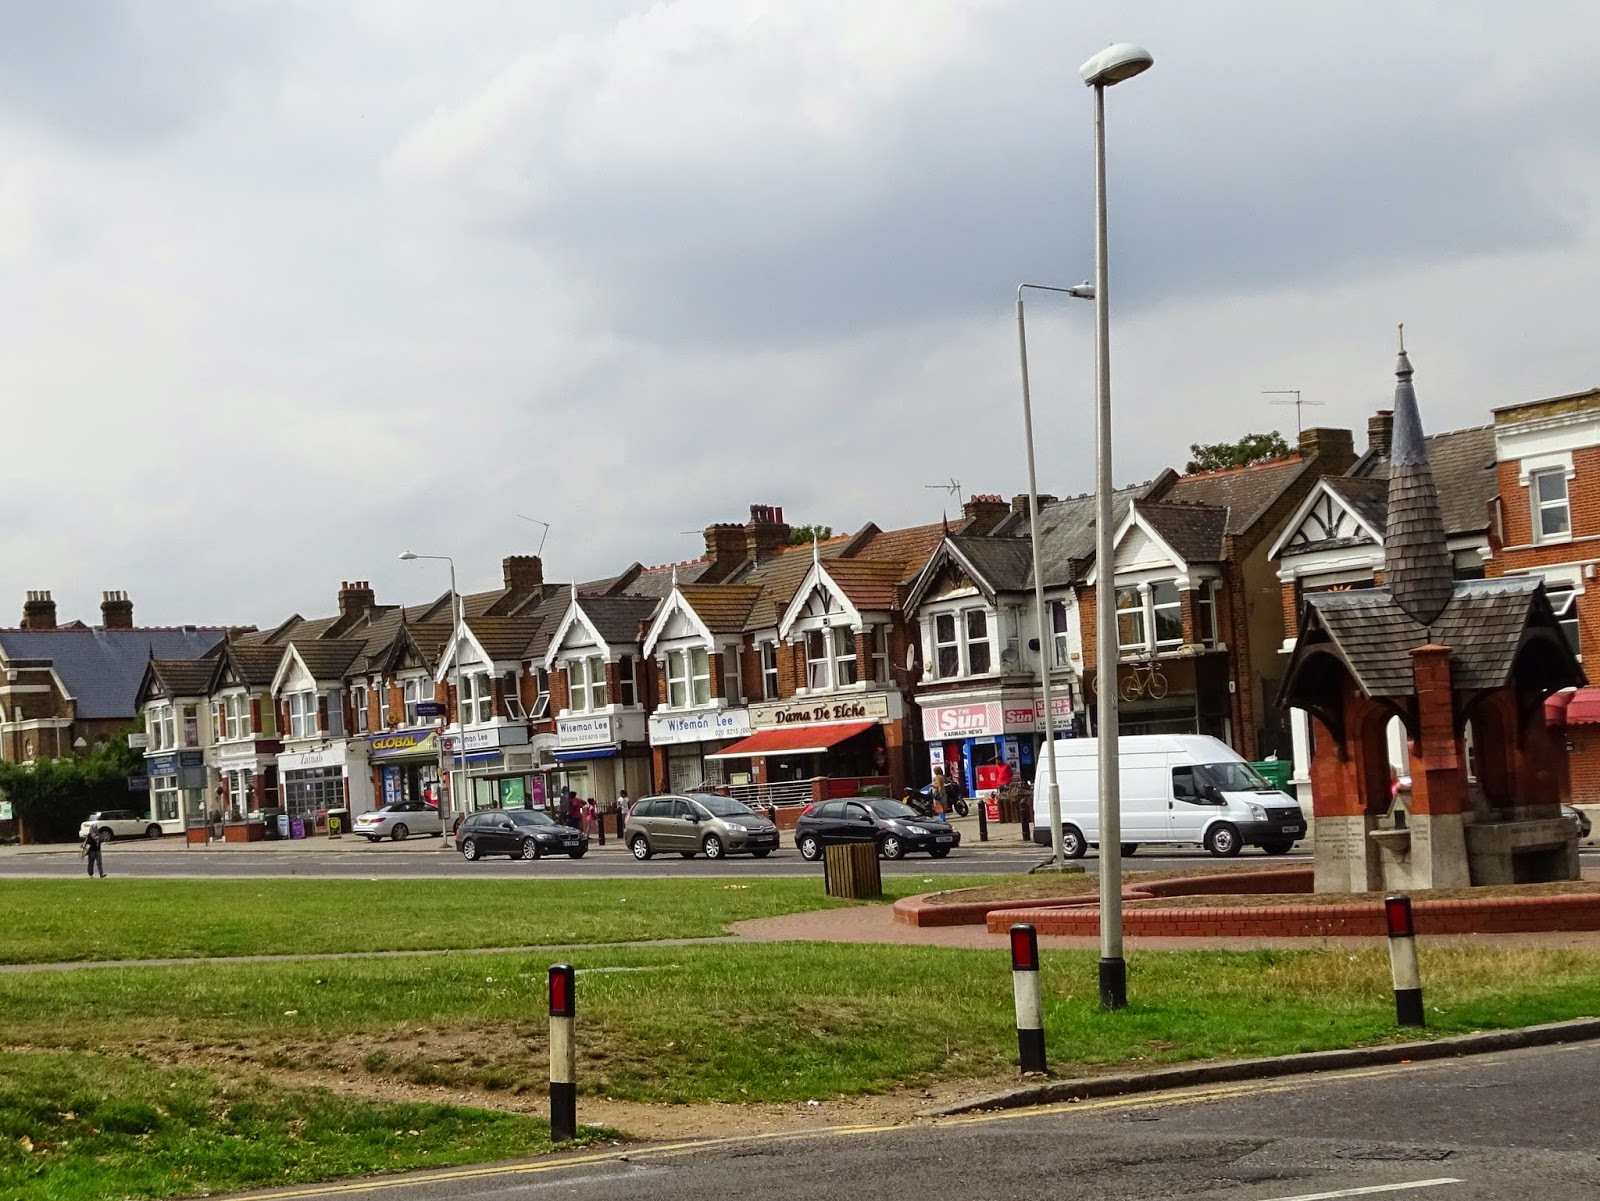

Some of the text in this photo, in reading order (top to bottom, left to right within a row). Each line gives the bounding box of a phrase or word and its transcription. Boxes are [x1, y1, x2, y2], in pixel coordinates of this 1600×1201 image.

[1036, 699, 1062, 709] NWS
[775, 707, 811, 724] Dama
[813, 706, 831, 720] De
[833, 702, 866, 719] Elche
[1006, 710, 1032, 723] Sun
[1038, 706, 1070, 717] WRLD
[668, 715, 733, 732] Wiseman Lee
[941, 709, 985, 730] Sun
[560, 720, 608, 733] Wiseman Lee
[715, 730, 725, 738] 020
[727, 728, 739, 736] 8215
[944, 729, 967, 737] KARMADI
[372, 736, 418, 750] GLOBAL
[478, 733, 488, 741] Lee
